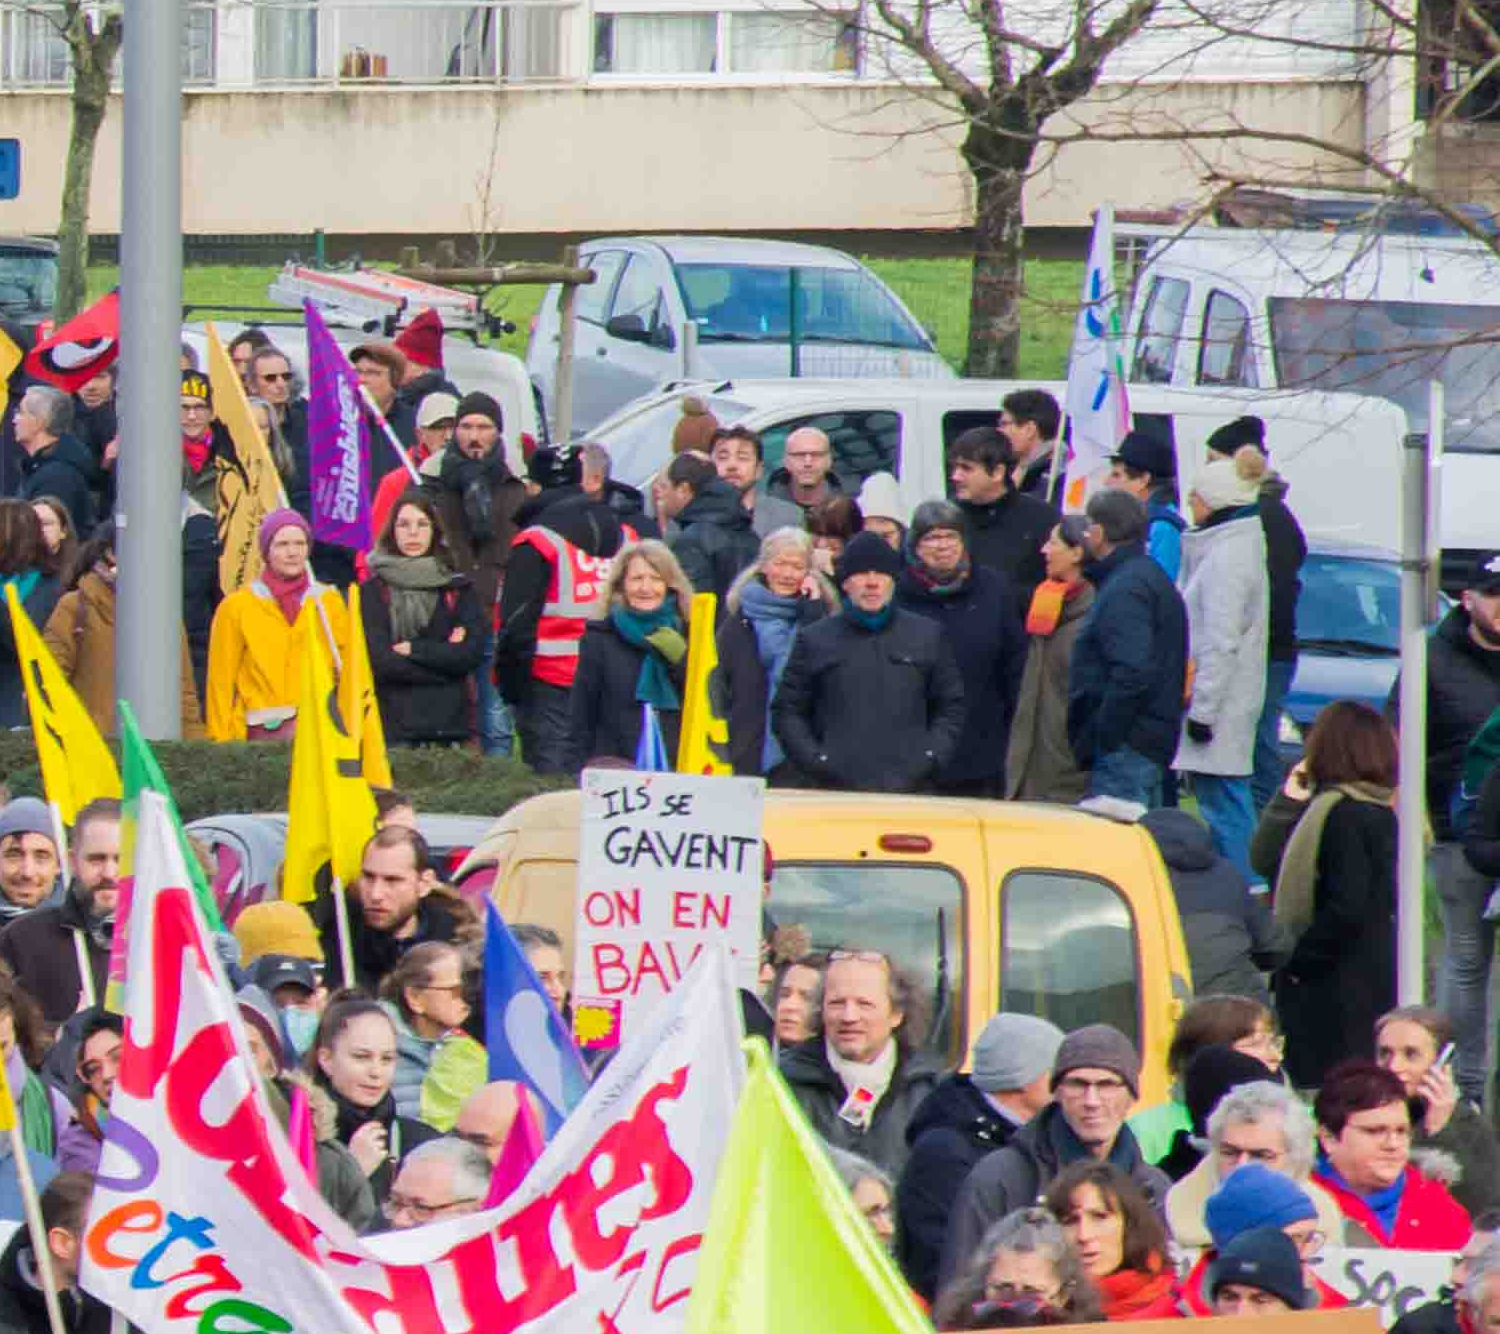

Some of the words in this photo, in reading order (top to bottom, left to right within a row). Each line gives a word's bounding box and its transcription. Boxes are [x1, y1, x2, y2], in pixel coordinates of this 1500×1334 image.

[601, 783, 652, 820] ILS
[659, 793, 693, 817] SE
[604, 825, 759, 875] GAVENT
[584, 888, 642, 927] ON
[672, 890, 732, 929] EN
[591, 940, 705, 997] BAV
